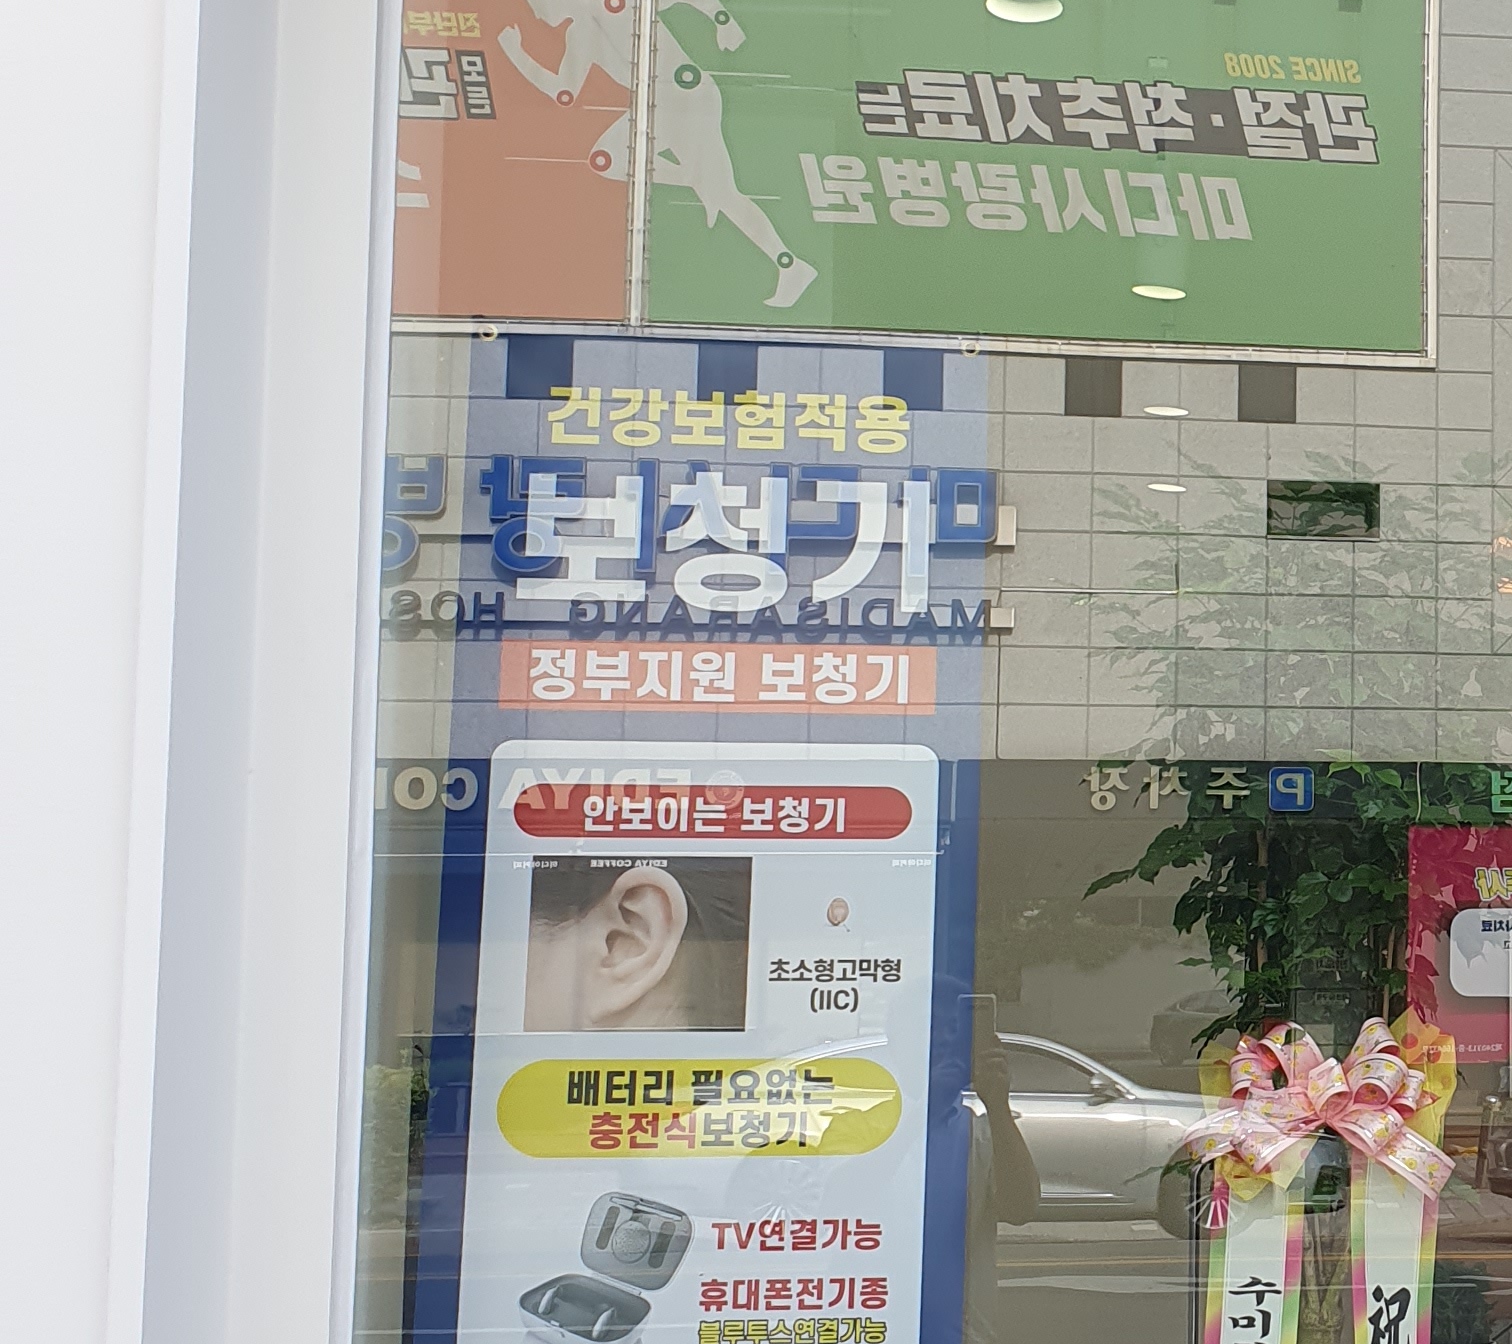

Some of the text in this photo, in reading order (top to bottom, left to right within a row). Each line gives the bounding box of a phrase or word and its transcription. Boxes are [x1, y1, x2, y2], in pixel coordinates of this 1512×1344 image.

[547, 386, 910, 455] 건강보험적용
[516, 471, 930, 613] 보청기
[528, 647, 909, 706] 정부지원 보청기
[582, 795, 847, 834] 안보이는 보청기
[768, 958, 902, 984] 초소형고막형
[809, 987, 859, 1013] (IIC)
[566, 1068, 834, 1107] 배터리 필요없는
[588, 1111, 807, 1150] 충전식보청기
[711, 1219, 882, 1251] TV연결가능
[699, 1277, 889, 1311] 휴대폰전기종
